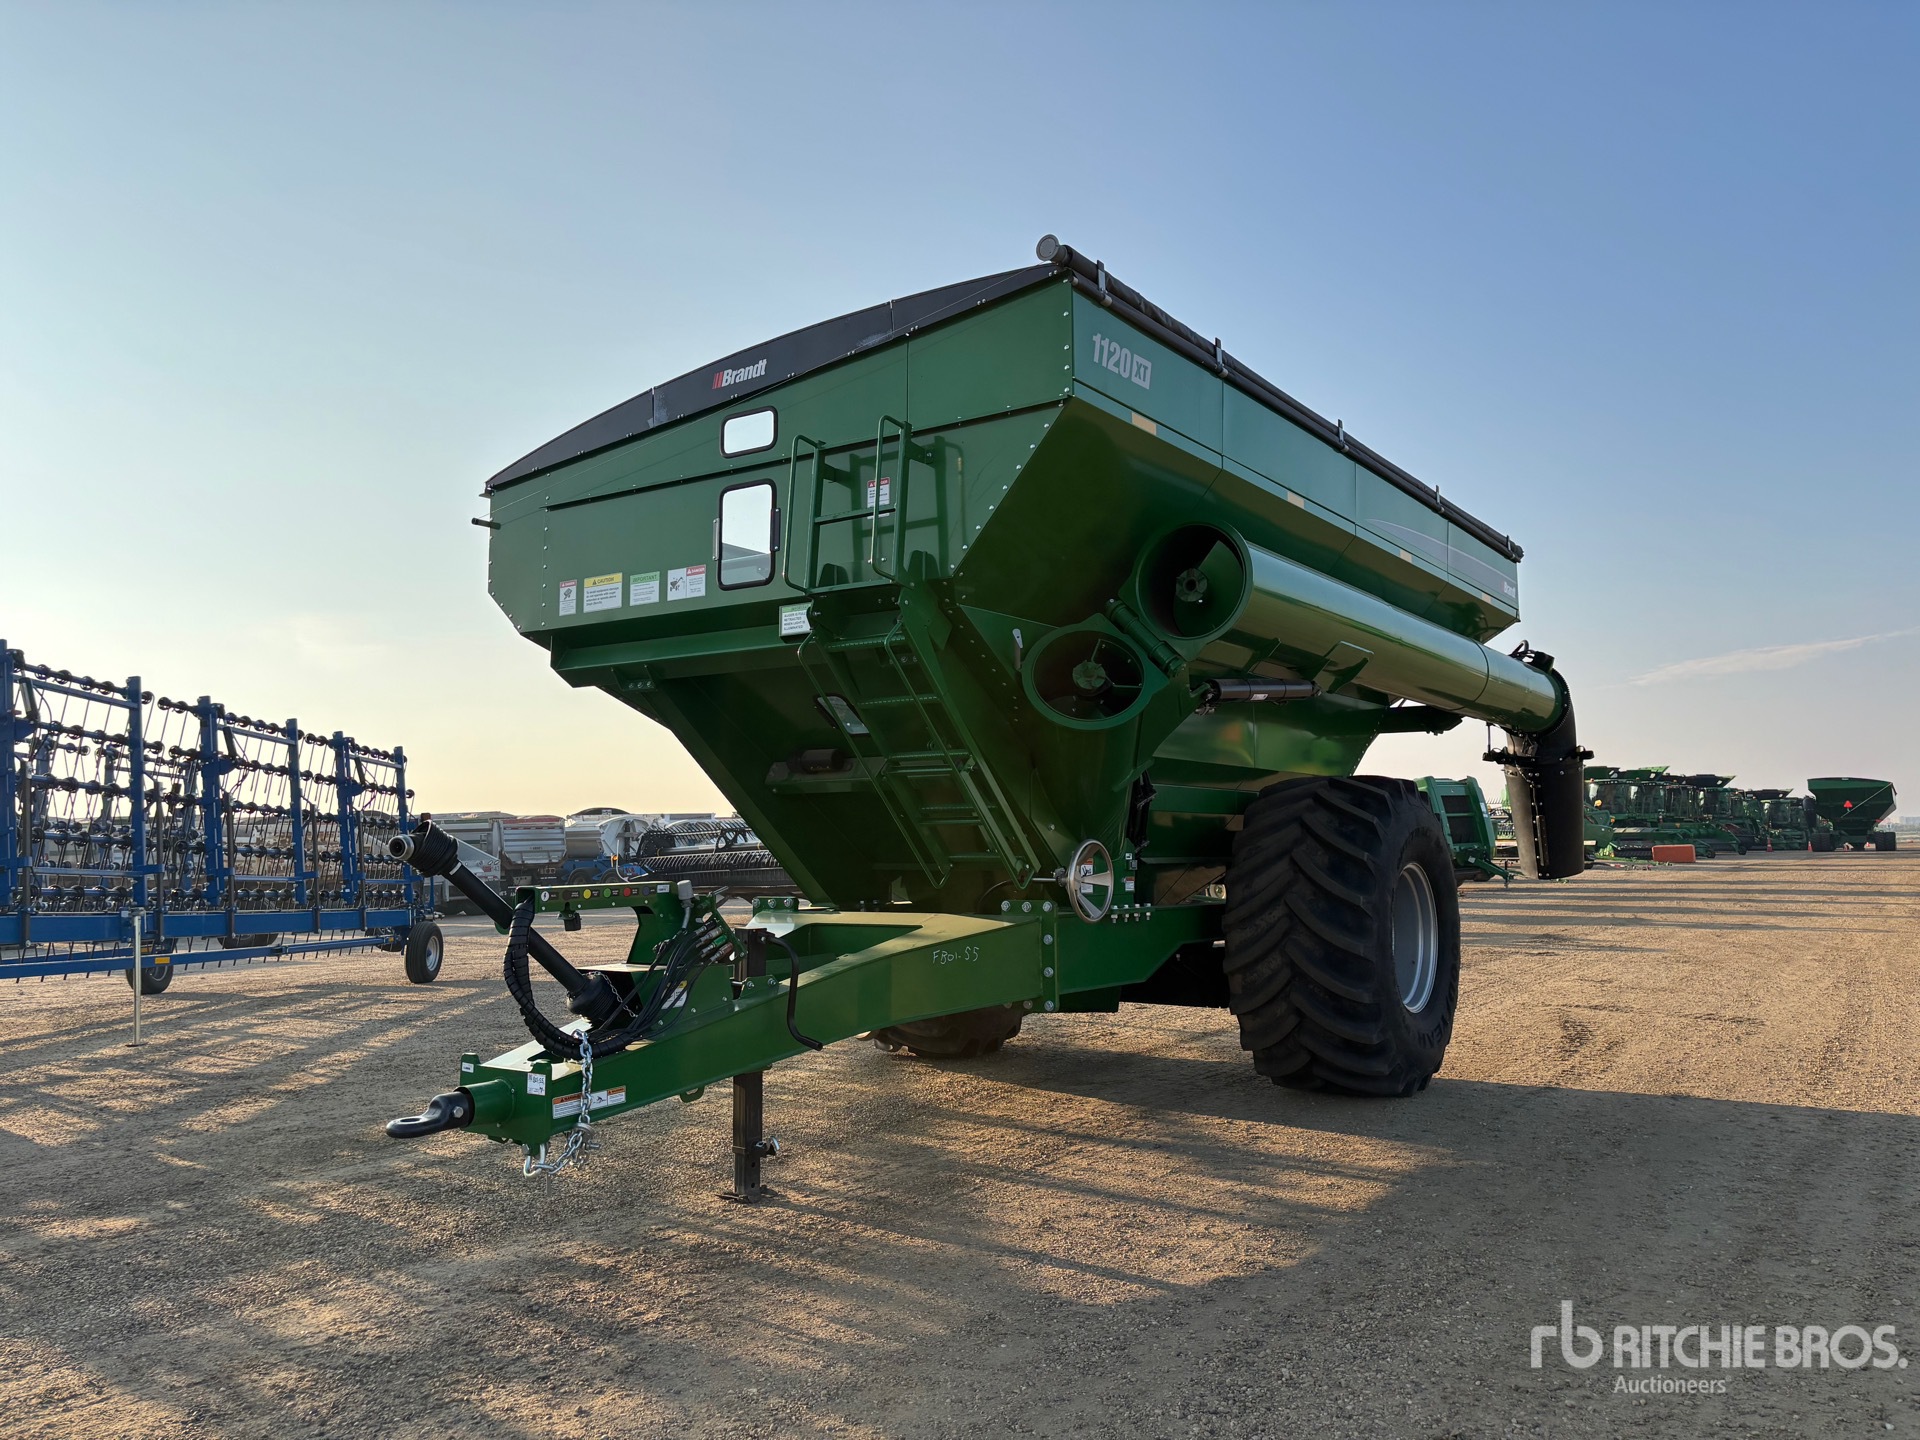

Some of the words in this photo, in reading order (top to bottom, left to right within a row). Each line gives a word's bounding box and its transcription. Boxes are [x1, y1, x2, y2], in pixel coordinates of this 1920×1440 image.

[721, 359, 767, 387] Brandt
[1092, 332, 1132, 379] 1120
[1133, 358, 1150, 385] XT
